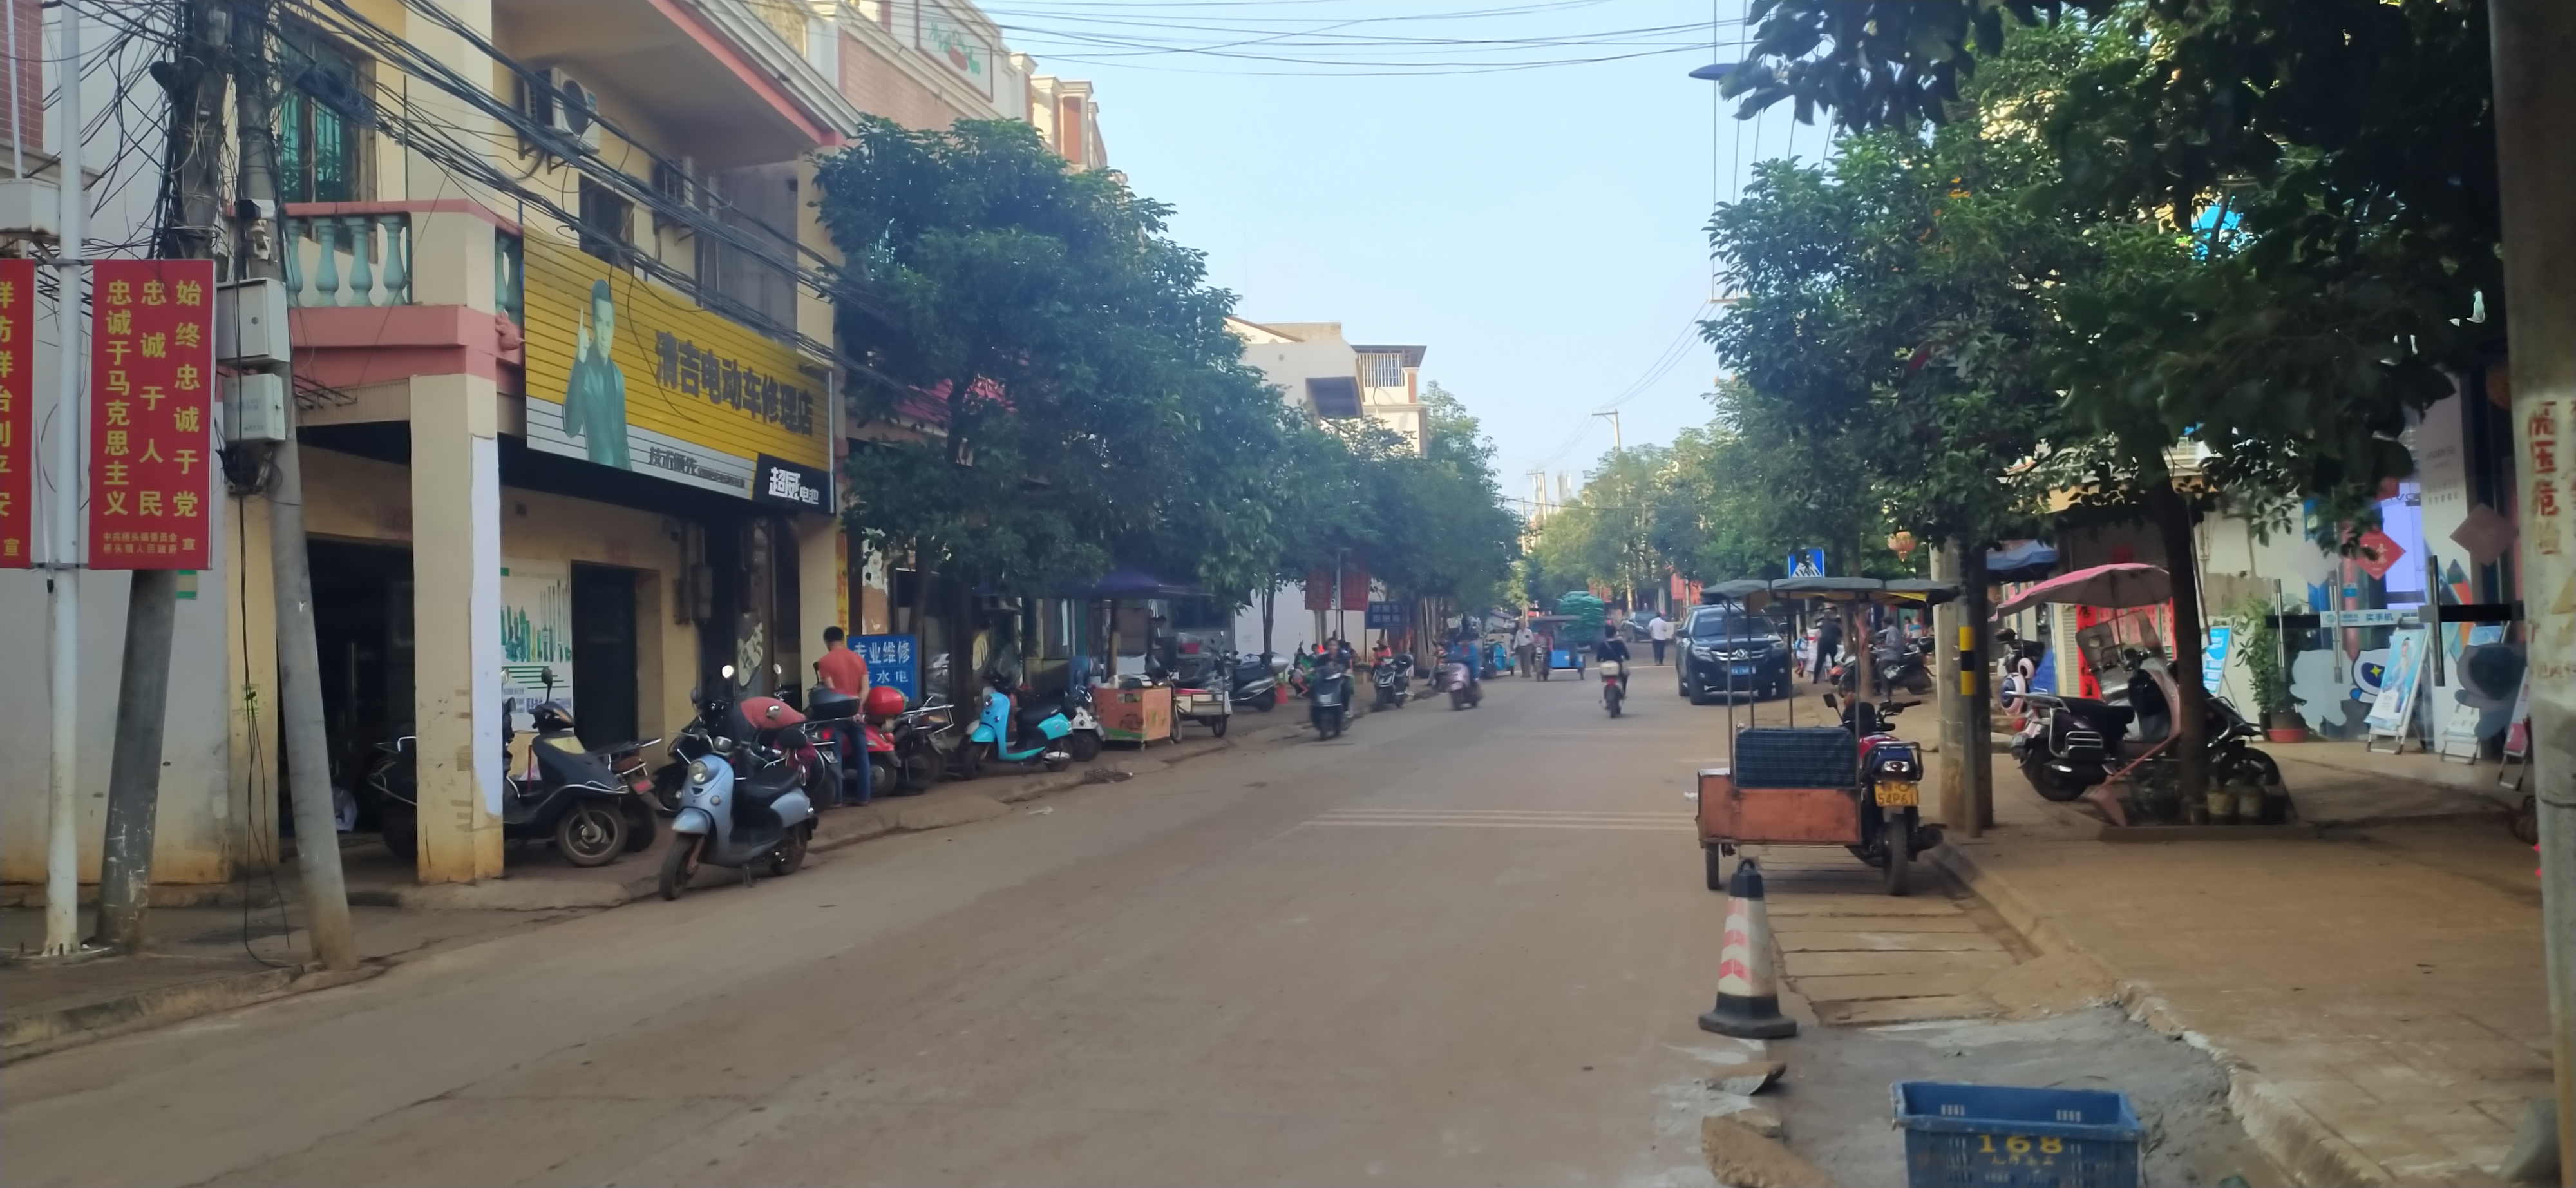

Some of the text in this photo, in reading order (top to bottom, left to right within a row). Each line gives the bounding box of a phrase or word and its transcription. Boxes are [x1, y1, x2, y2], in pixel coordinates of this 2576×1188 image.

[104, 279, 132, 516] 忠诚于马克思主义
[139, 279, 167, 516] 忠诚于人民
[173, 279, 202, 517] 始终忠诚于党
[103, 532, 177, 542] 中共桥头镇委员会
[182, 537, 195, 550] 宣
[3, 538, 19, 557] 宣
[103, 542, 177, 554] 桥头镇人民政府
[854, 640, 910, 664] 专业维修
[867, 669, 909, 684] 水电
[1978, 1135, 2063, 1154] 168
